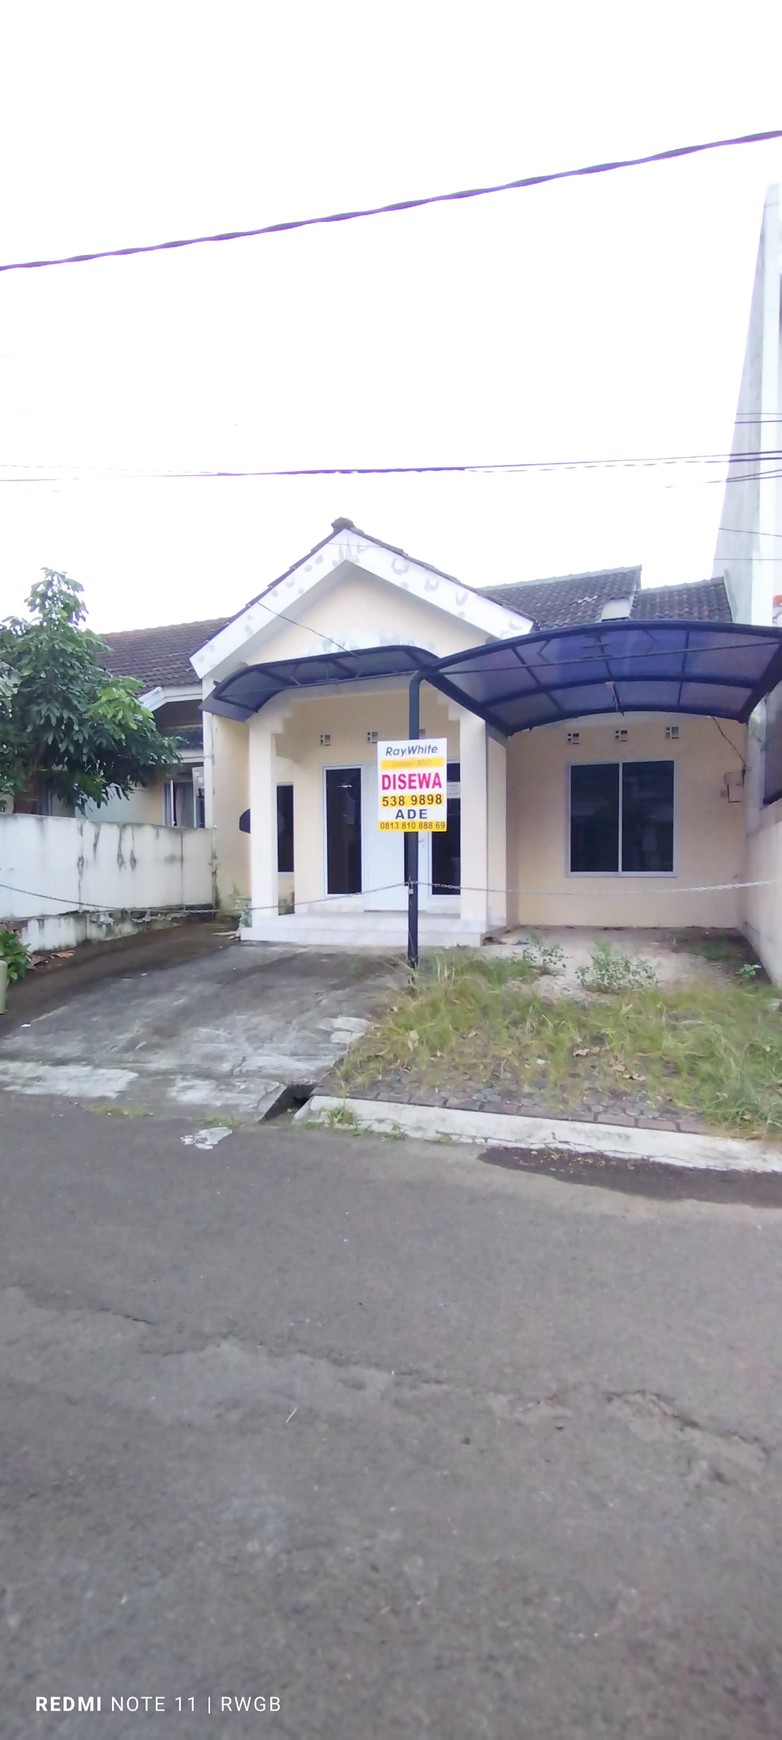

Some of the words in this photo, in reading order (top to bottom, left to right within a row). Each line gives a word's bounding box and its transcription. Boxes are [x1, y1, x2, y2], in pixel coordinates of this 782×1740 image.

[382, 772, 442, 790] DISEWA
[382, 796, 405, 806] 538
[410, 794, 442, 805] 9898
[395, 809, 428, 819] ADE
[380, 821, 399, 829] 0813
[418, 821, 433, 829] 888
[435, 821, 445, 829] 69
